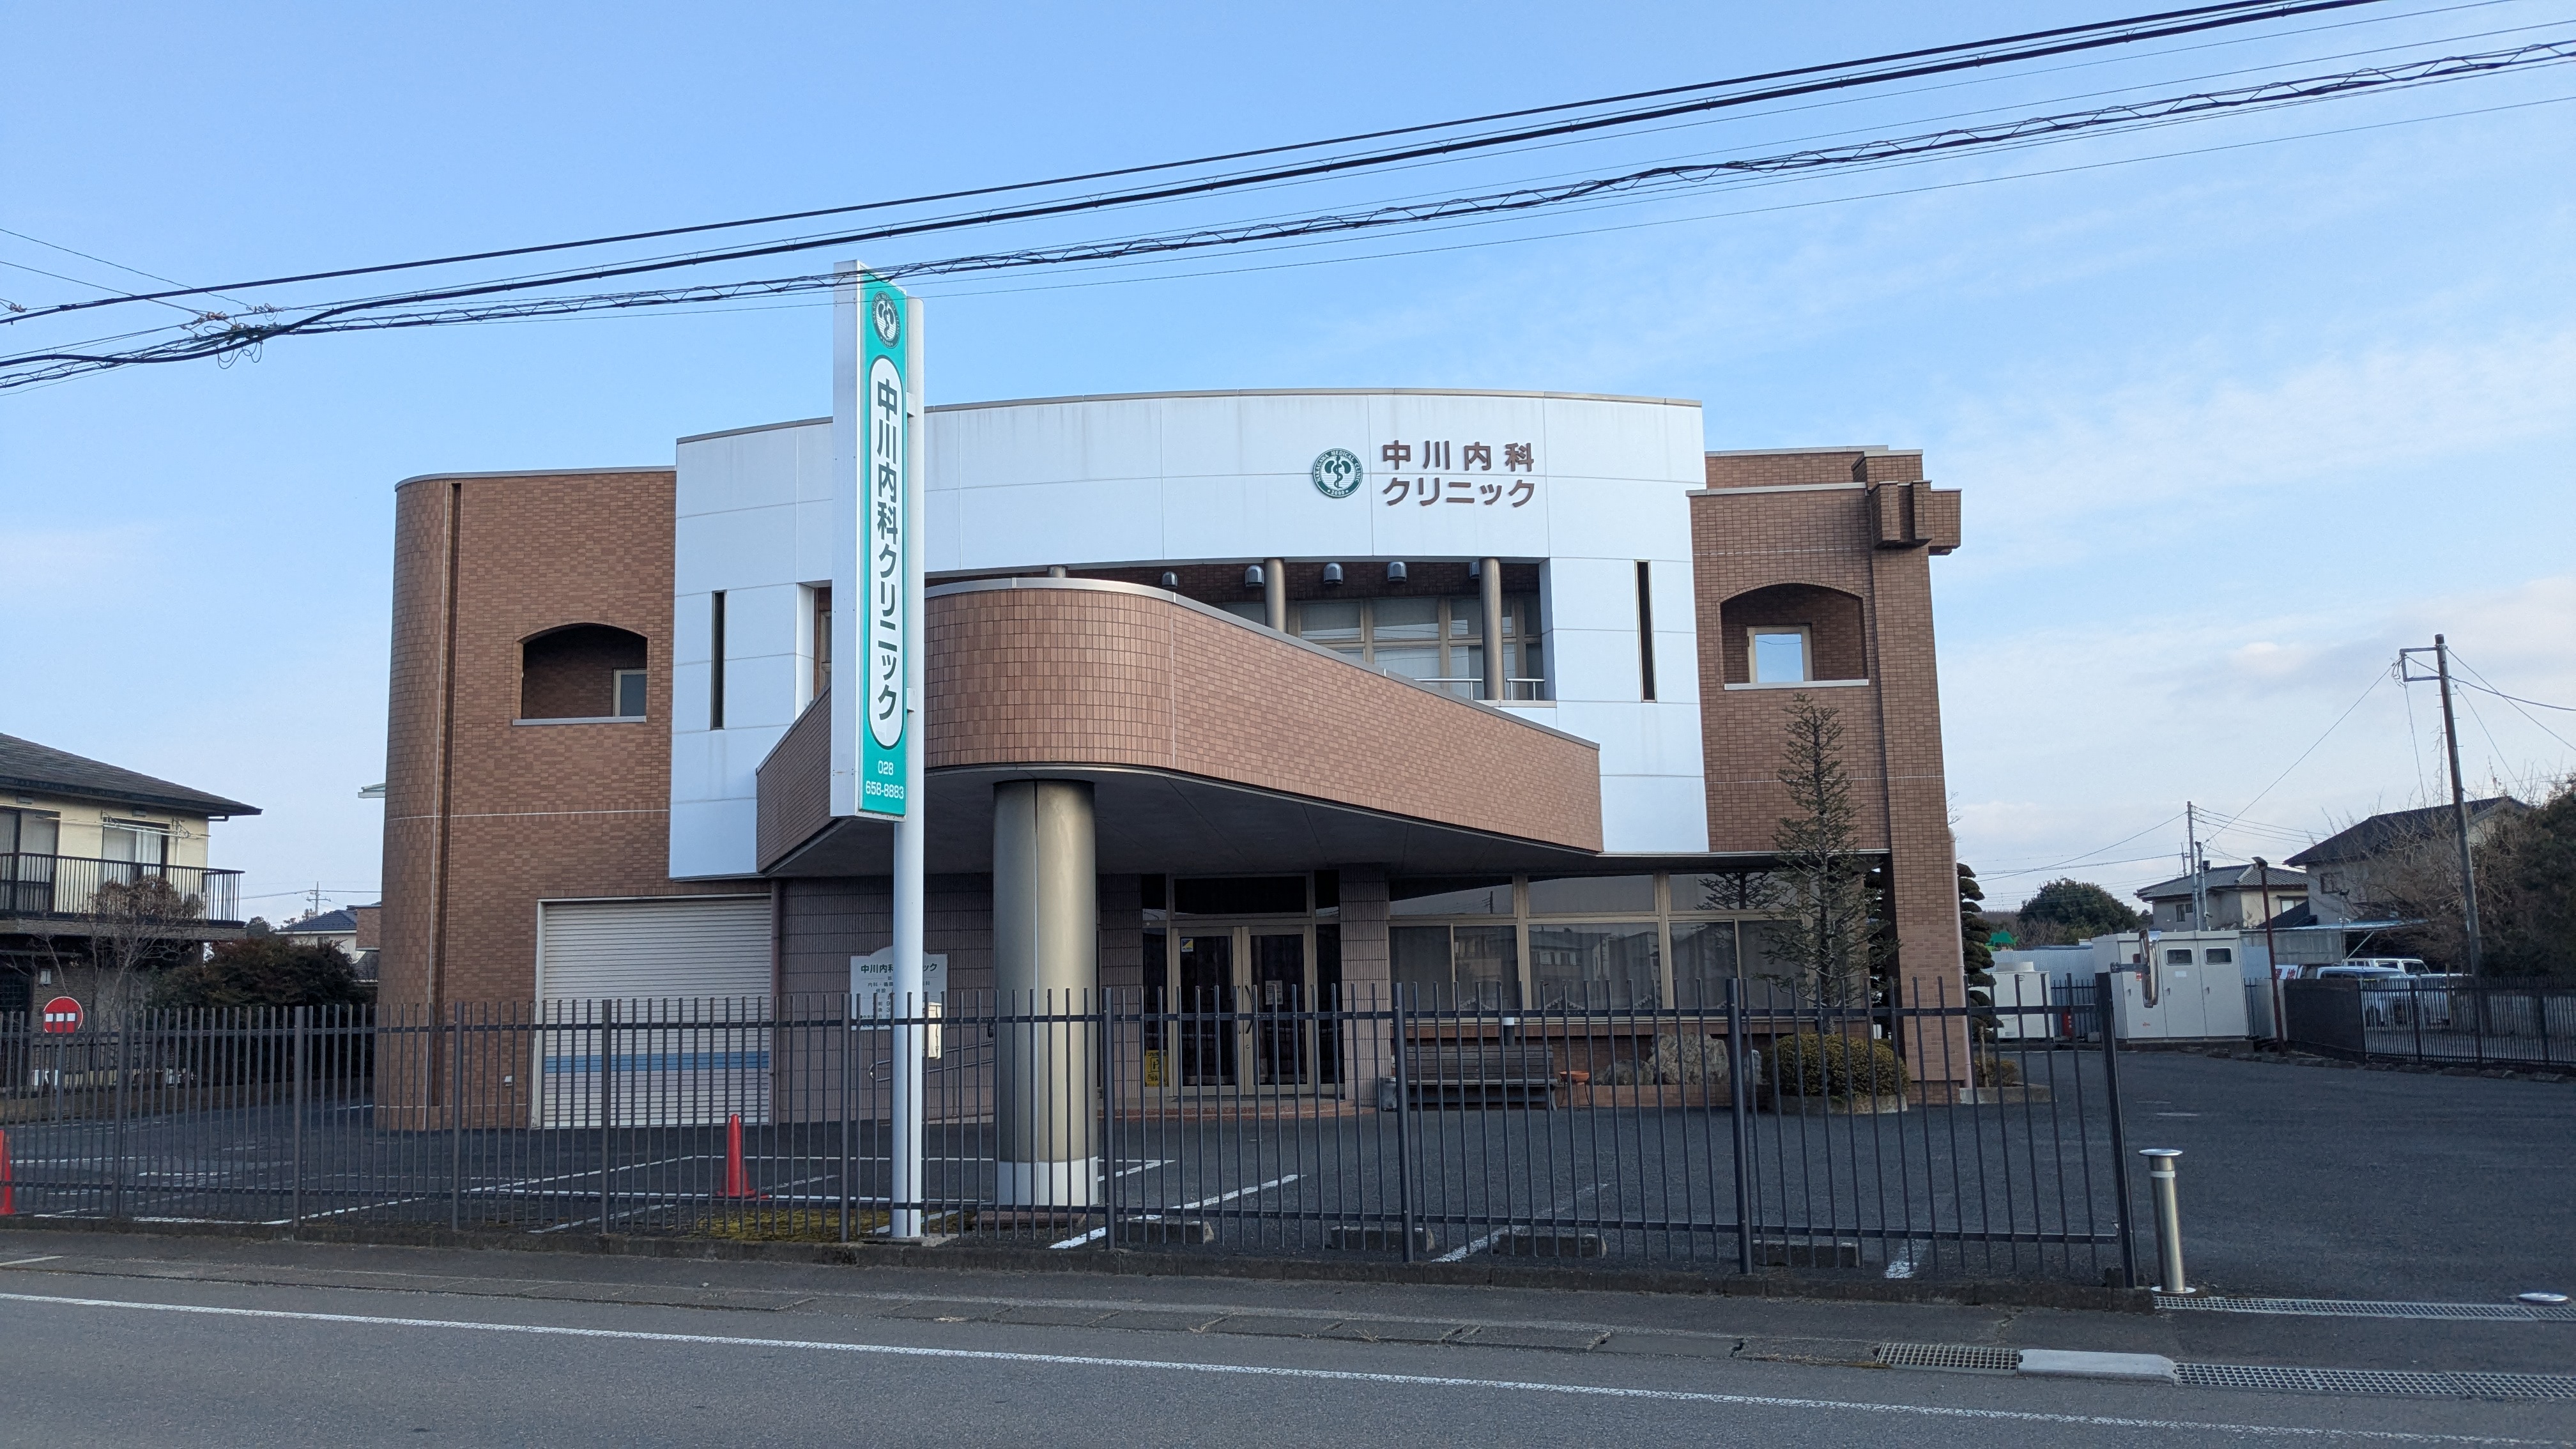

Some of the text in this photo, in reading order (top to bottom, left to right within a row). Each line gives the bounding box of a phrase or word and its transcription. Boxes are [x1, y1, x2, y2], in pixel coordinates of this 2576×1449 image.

[1315, 454, 1330, 482] NAKAGAWA
[1331, 450, 1354, 462] MEDICAL
[1382, 440, 1535, 473] 中川内科
[1382, 477, 1535, 508] クリニック
[877, 378, 898, 721] 中川内科クリニック
[878, 760, 894, 776] 028
[866, 780, 904, 799] 658-8883
